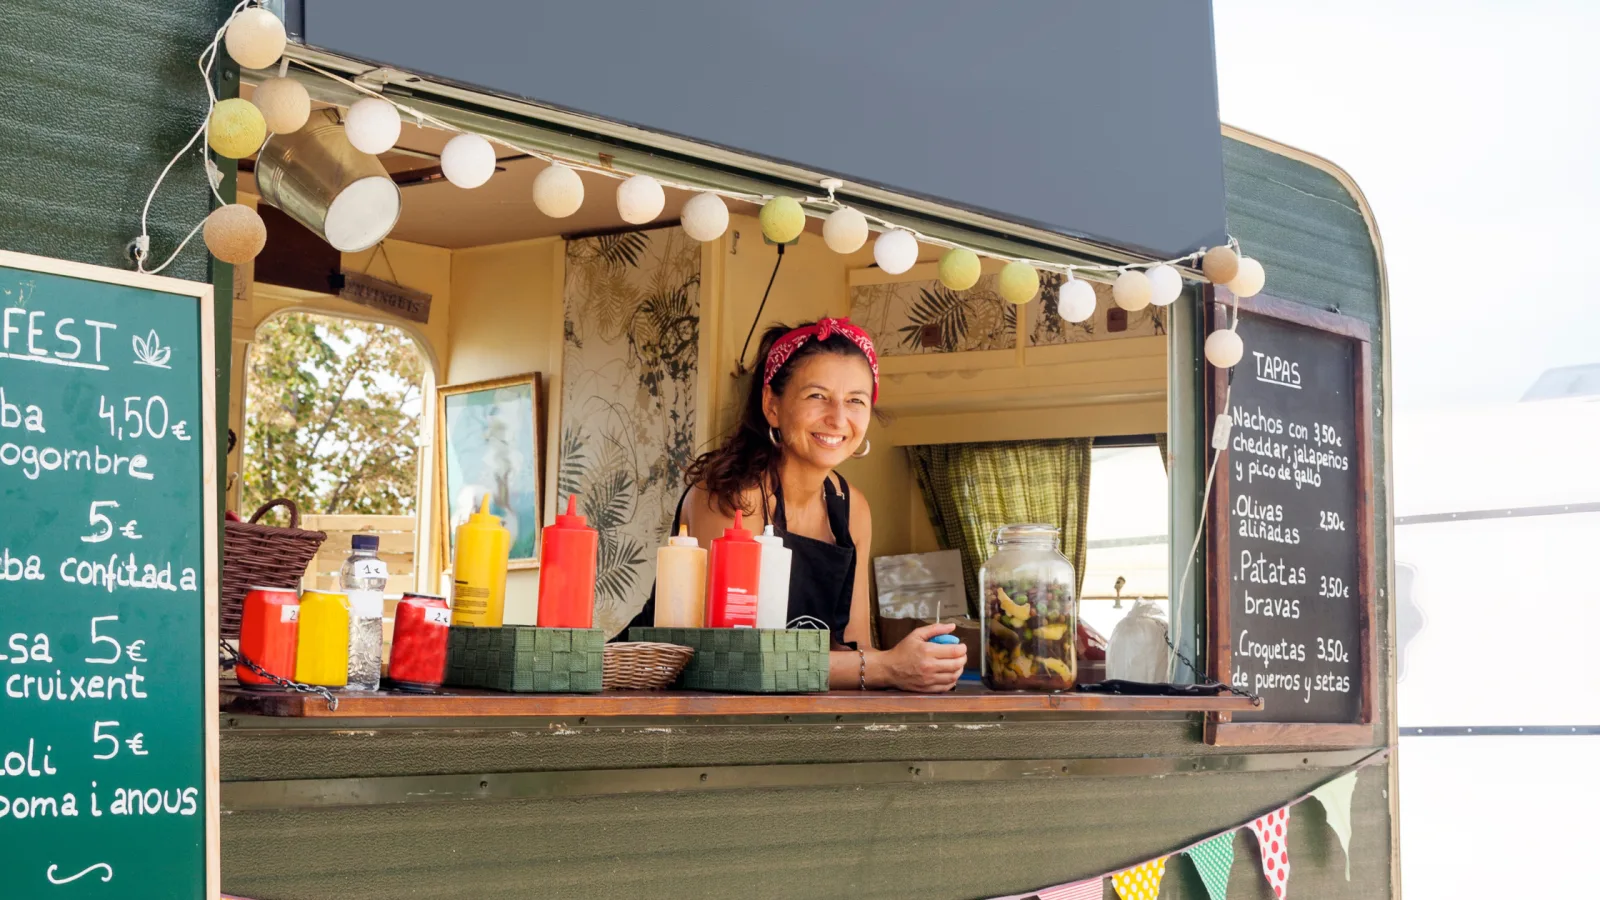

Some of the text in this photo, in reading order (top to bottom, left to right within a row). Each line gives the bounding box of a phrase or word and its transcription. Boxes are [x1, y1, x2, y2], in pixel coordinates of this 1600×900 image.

[3, 307, 117, 362] FEST
[1253, 351, 1301, 384] TAPAS
[1288, 422, 1309, 440] con
[1293, 444, 1348, 471] jalapeños
[1235, 460, 1243, 481] y
[1294, 468, 1321, 489] gallo
[1239, 519, 1300, 544] aliñadas
[1245, 590, 1300, 619] bravas
[6, 666, 147, 700] cruixent
[1232, 665, 1350, 703] de puerros y setas
[91, 781, 102, 817] i
[110, 786, 198, 816] anous
